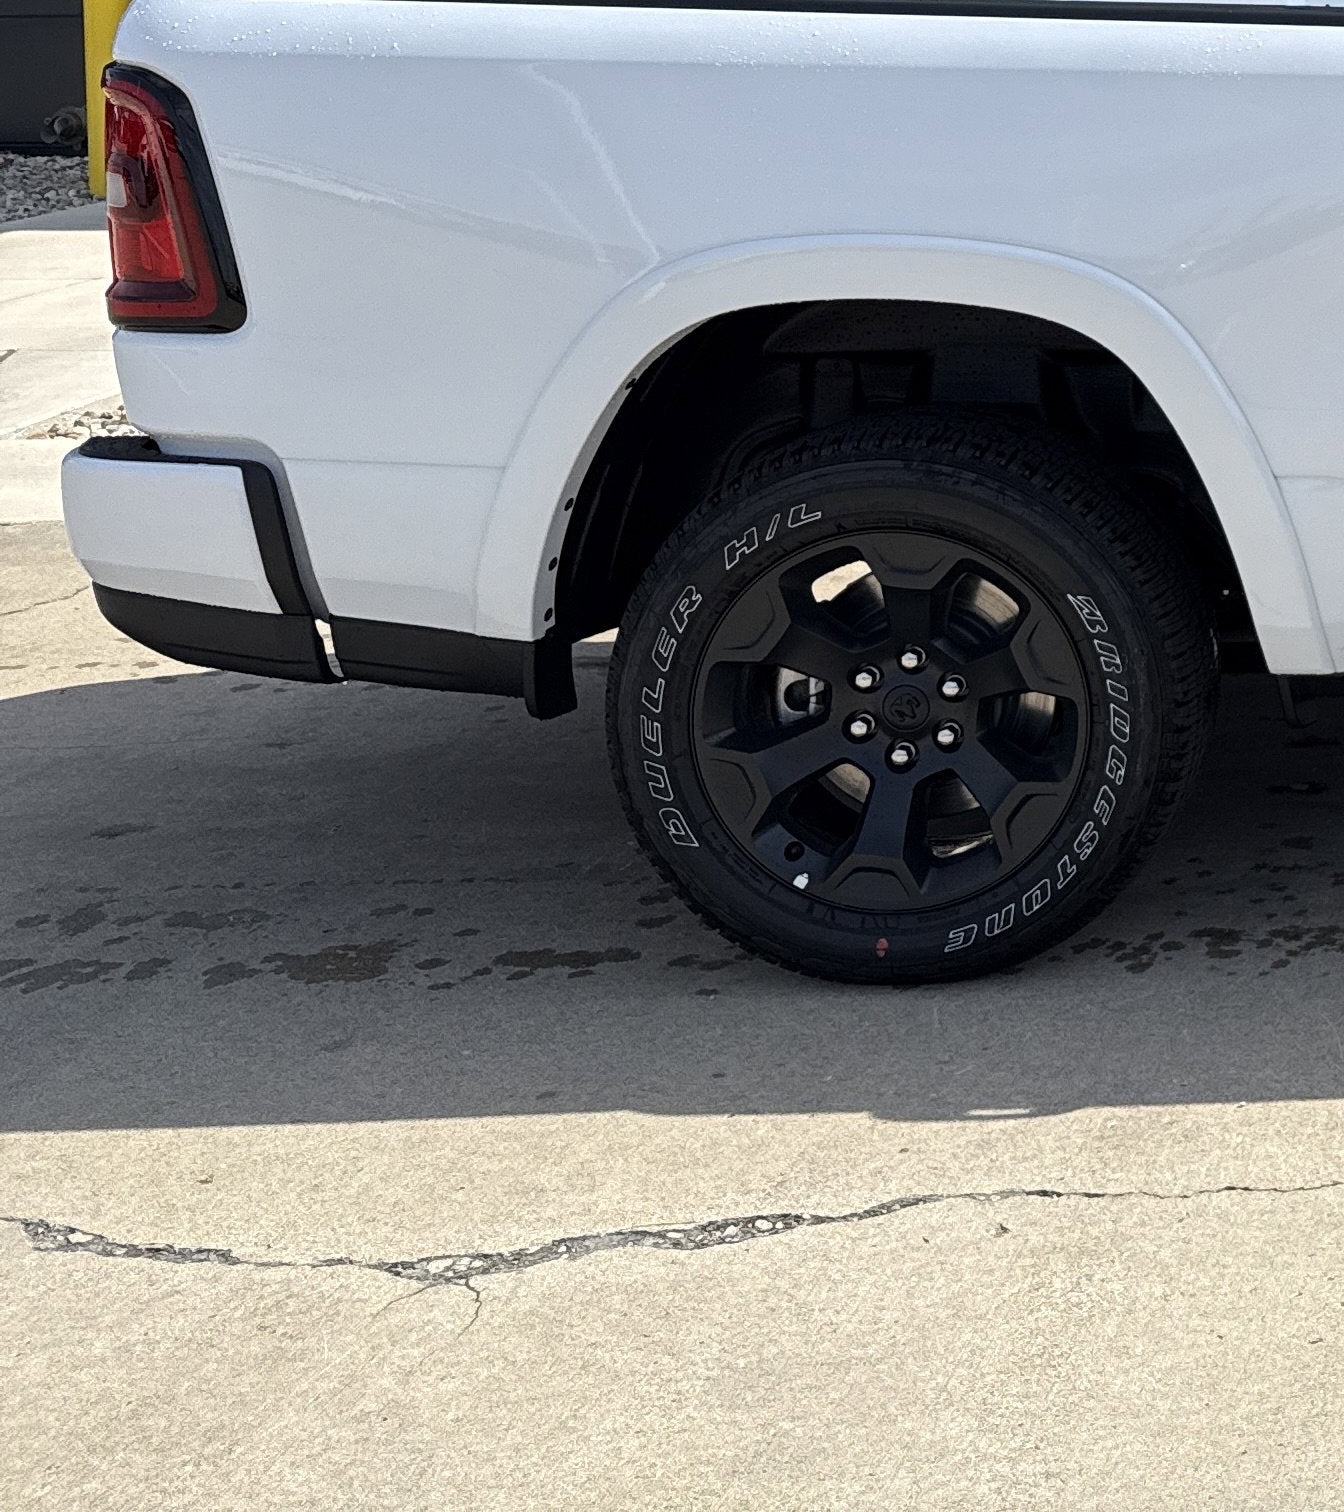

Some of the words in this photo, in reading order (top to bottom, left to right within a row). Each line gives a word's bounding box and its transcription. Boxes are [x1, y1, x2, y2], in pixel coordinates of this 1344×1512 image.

[639, 586, 702, 847] DUELER
[725, 504, 821, 569] H/L
[945, 594, 1130, 953] BRIDGESTONE
